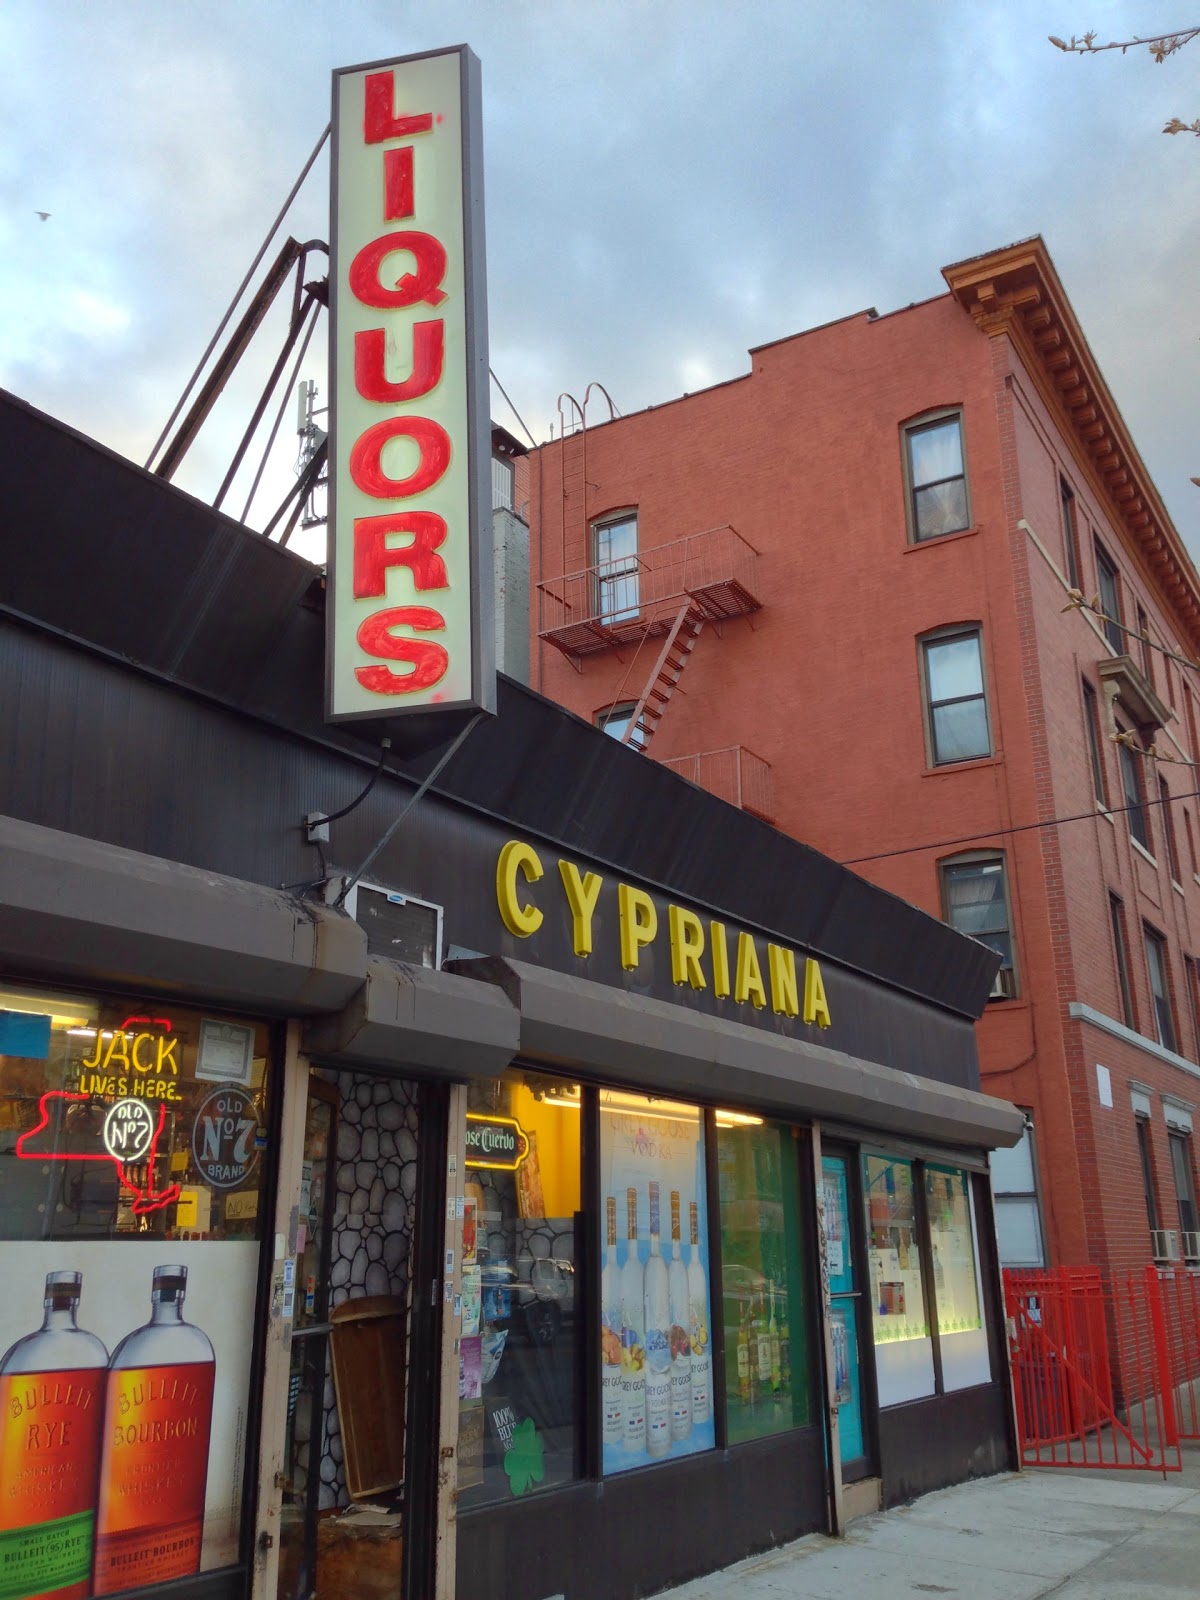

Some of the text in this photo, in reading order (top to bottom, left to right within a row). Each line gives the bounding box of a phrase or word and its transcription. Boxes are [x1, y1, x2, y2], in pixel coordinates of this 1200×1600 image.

[349, 70, 452, 696] LIQUORS
[496, 839, 832, 1029] CYPRIANA
[82, 1028, 178, 1075] JACK
[80, 1074, 182, 1100] LIVES HERE
[118, 1104, 143, 1119] OLD
[216, 1097, 243, 1113] OLD
[465, 1127, 515, 1152] ose Cuervo
[630, 1140, 673, 1159] VODKA
[207, 1163, 246, 1181] BRAND
[492, 1406, 515, 1428] 100%
[26, 1421, 72, 1451] RYE
[113, 1416, 198, 1447] BOURBON
[497, 1421, 517, 1441] BLU
[46, 1530, 70, 1541] BATCH
[4, 1545, 46, 1563] BULLEIT
[110, 1549, 150, 1567] BULLEIT
[153, 1537, 195, 1557] BOURBON
